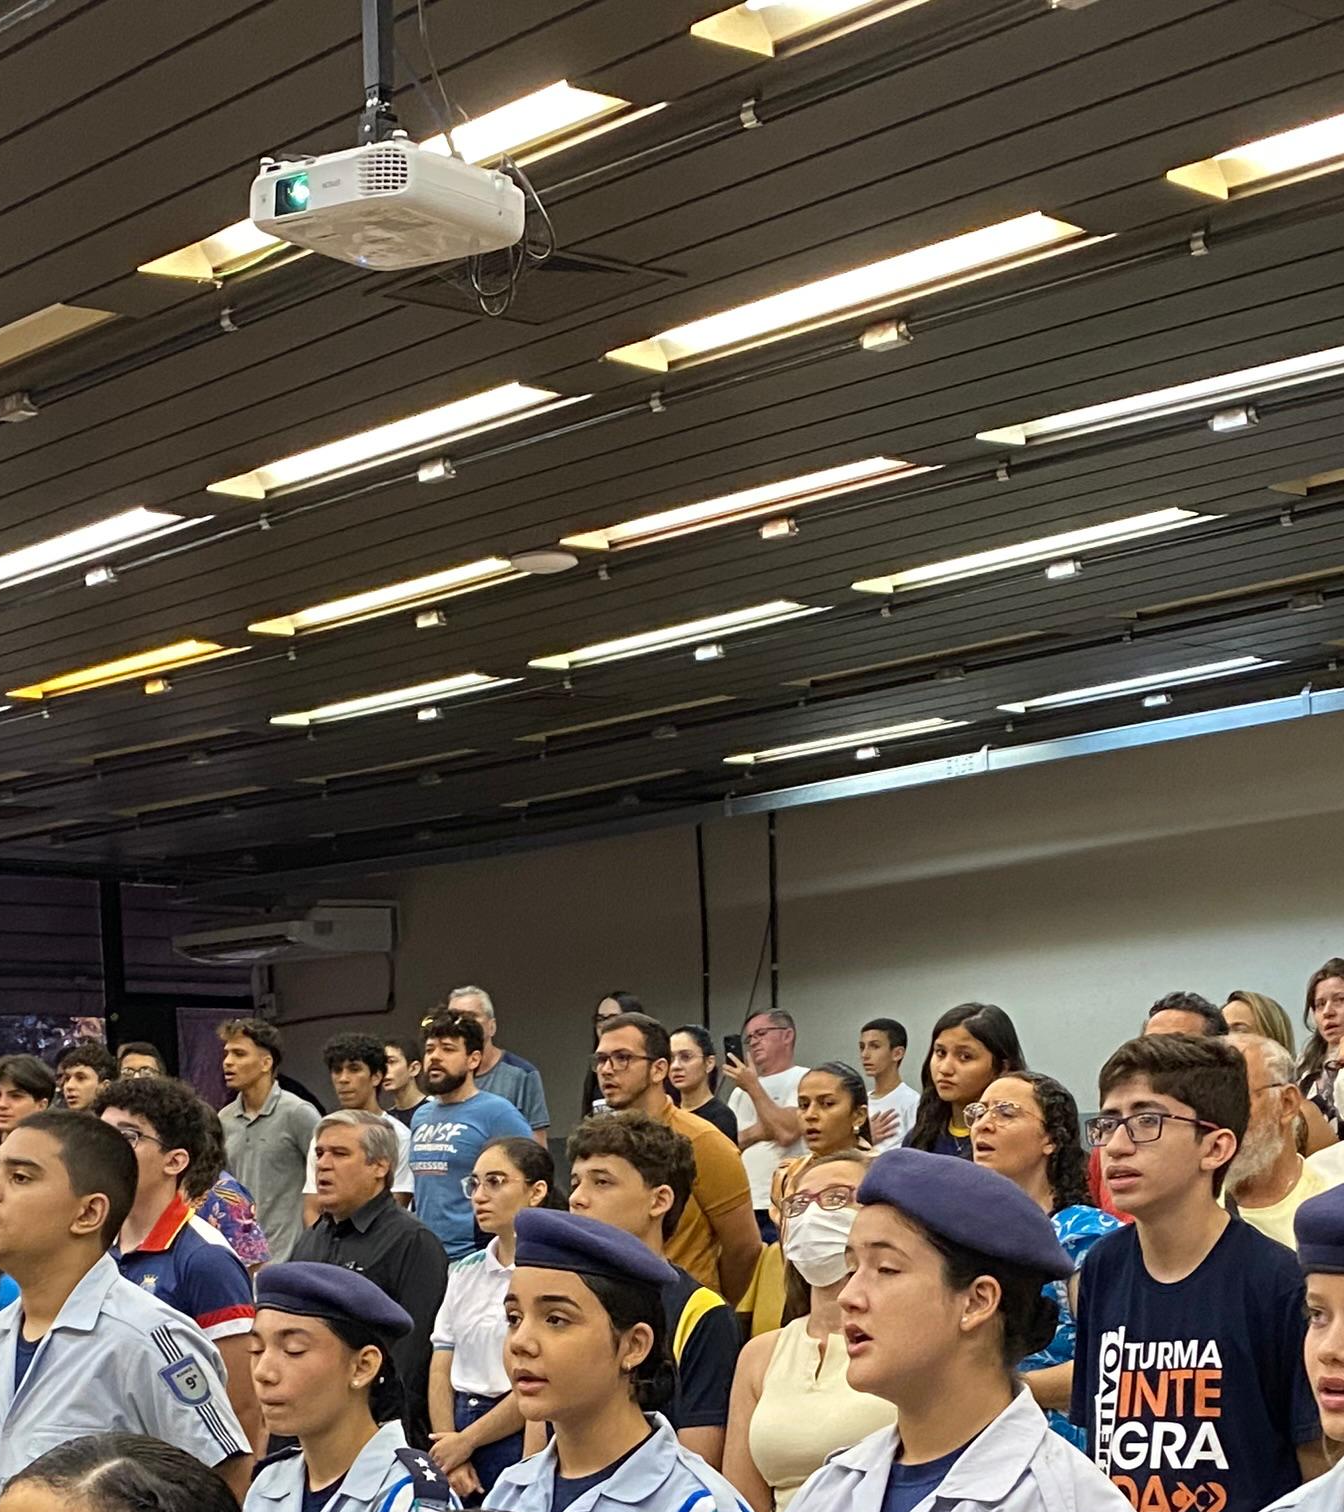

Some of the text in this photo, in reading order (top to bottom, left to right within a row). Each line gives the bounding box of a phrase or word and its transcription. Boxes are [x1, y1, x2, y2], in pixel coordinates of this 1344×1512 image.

[1124, 1339, 1223, 1371] TURMA
[1118, 1369, 1223, 1418] INTE
[1111, 1420, 1230, 1470] GRA
